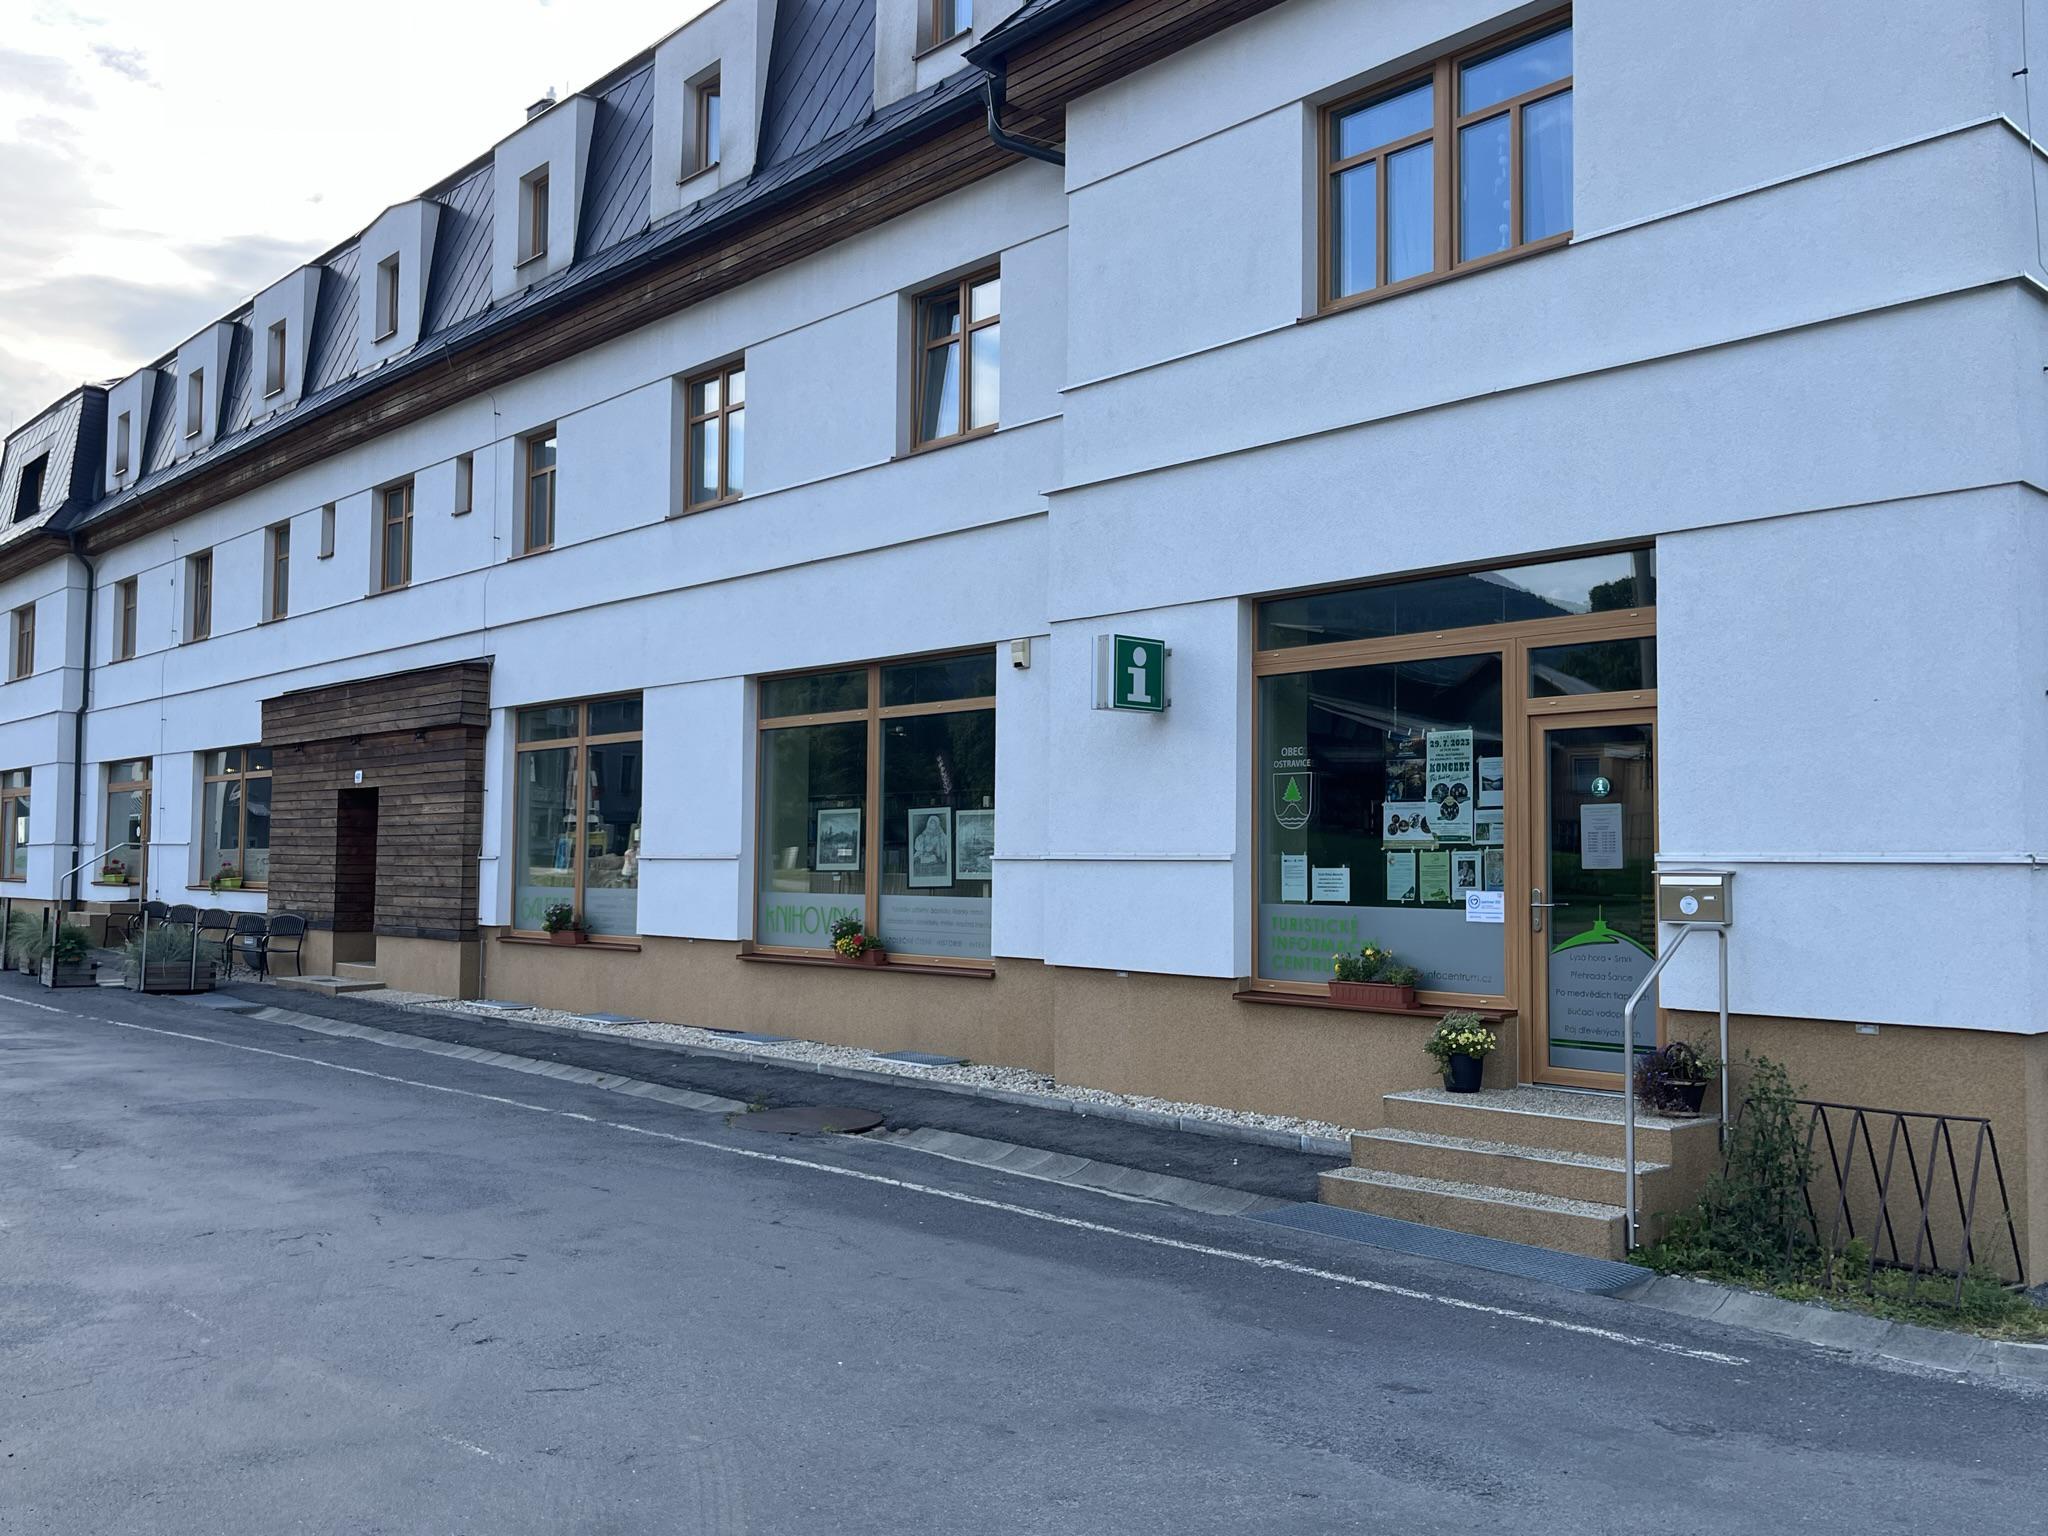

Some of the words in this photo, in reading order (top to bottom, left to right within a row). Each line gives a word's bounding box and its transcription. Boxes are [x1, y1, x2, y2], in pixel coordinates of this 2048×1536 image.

[1281, 746, 1304, 757] OBEC
[1273, 758, 1311, 768] OSTRAVICE
[1429, 761, 1470, 773] KONCERT
[1272, 914, 1359, 934] TURISTICKÉ
[1272, 955, 1338, 972] CENTRU
[1587, 954, 1607, 962] hora
[1570, 970, 1606, 981] Přehrada
[1607, 971, 1633, 982] Šance
[1555, 988, 1565, 996] Po
